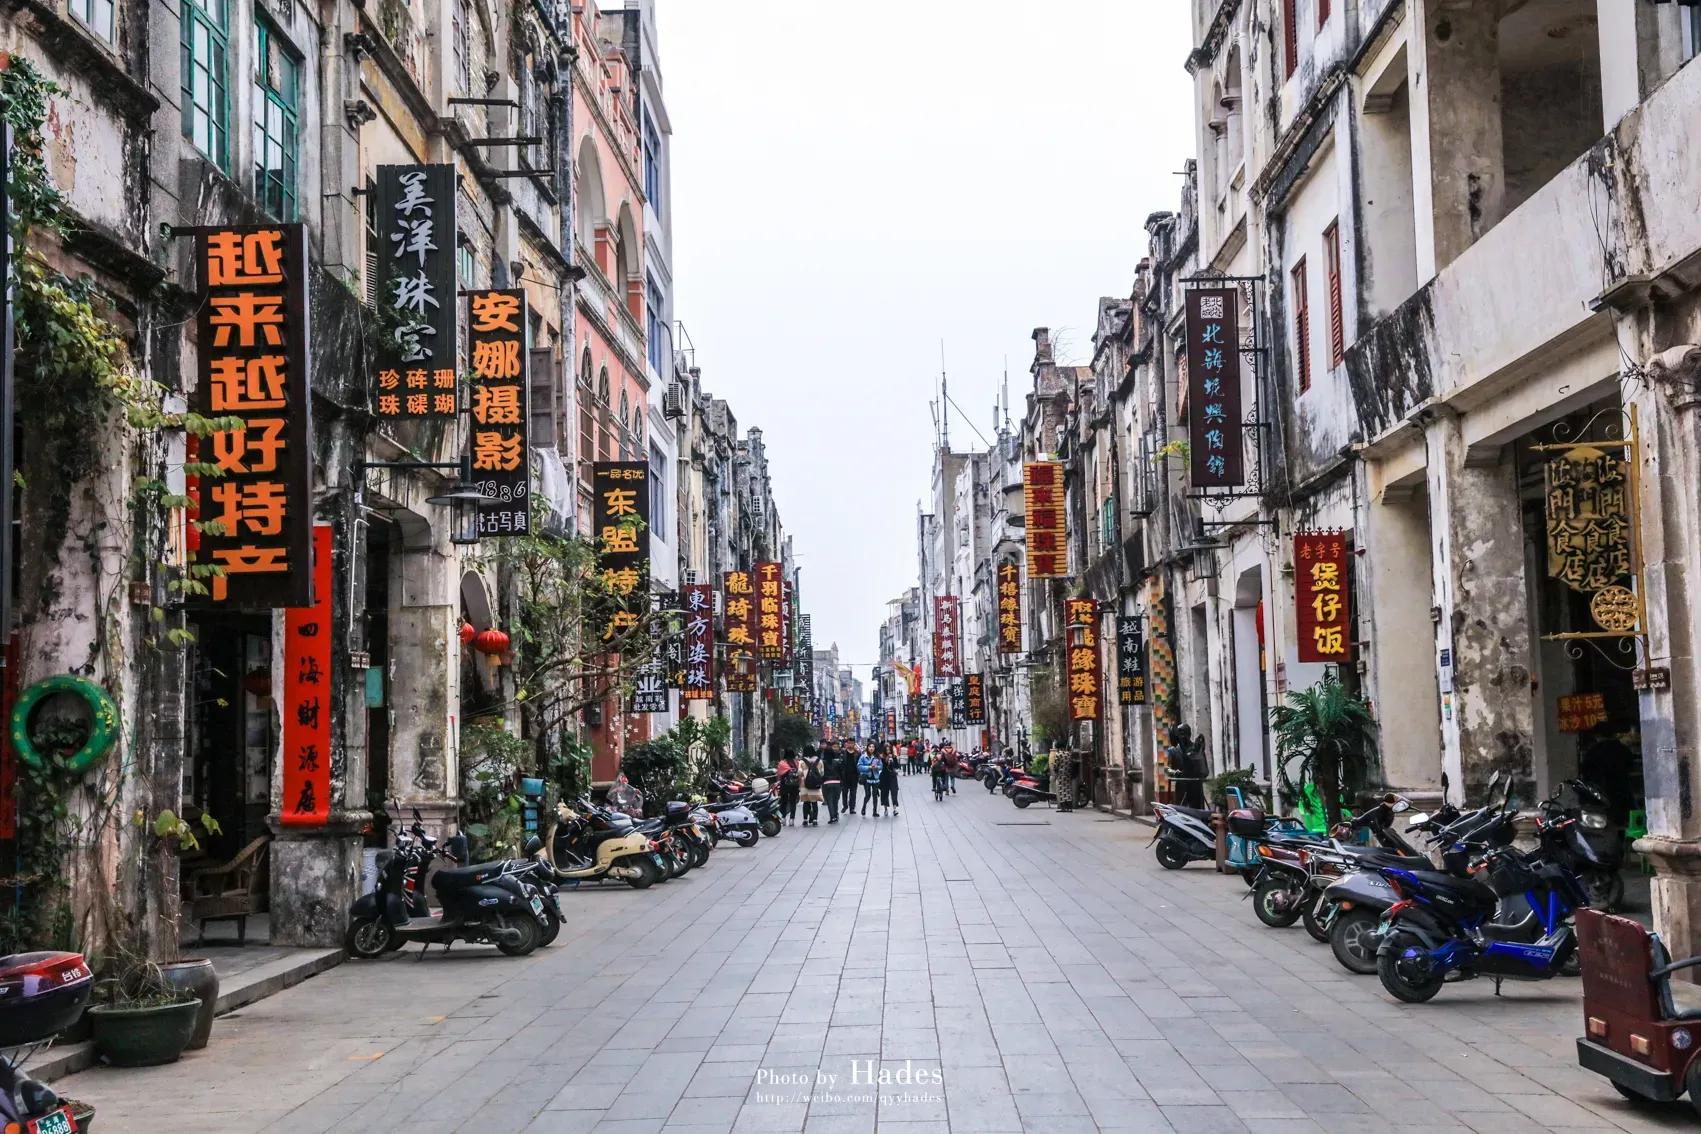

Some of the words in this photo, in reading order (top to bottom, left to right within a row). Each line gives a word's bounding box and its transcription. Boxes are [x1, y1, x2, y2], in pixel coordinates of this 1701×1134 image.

[472, 292, 522, 472] 安娜摄影
[207, 230, 288, 601] 越来越好特产
[597, 468, 645, 480] 一品名优
[602, 487, 640, 640] 东盟特产
[1300, 542, 1342, 560] 老字号
[1310, 562, 1345, 654] 煲仔饭
[1118, 620, 1142, 673] 越南鞋
[1120, 676, 1144, 687] 旅游
[1121, 690, 1145, 701] 用品
